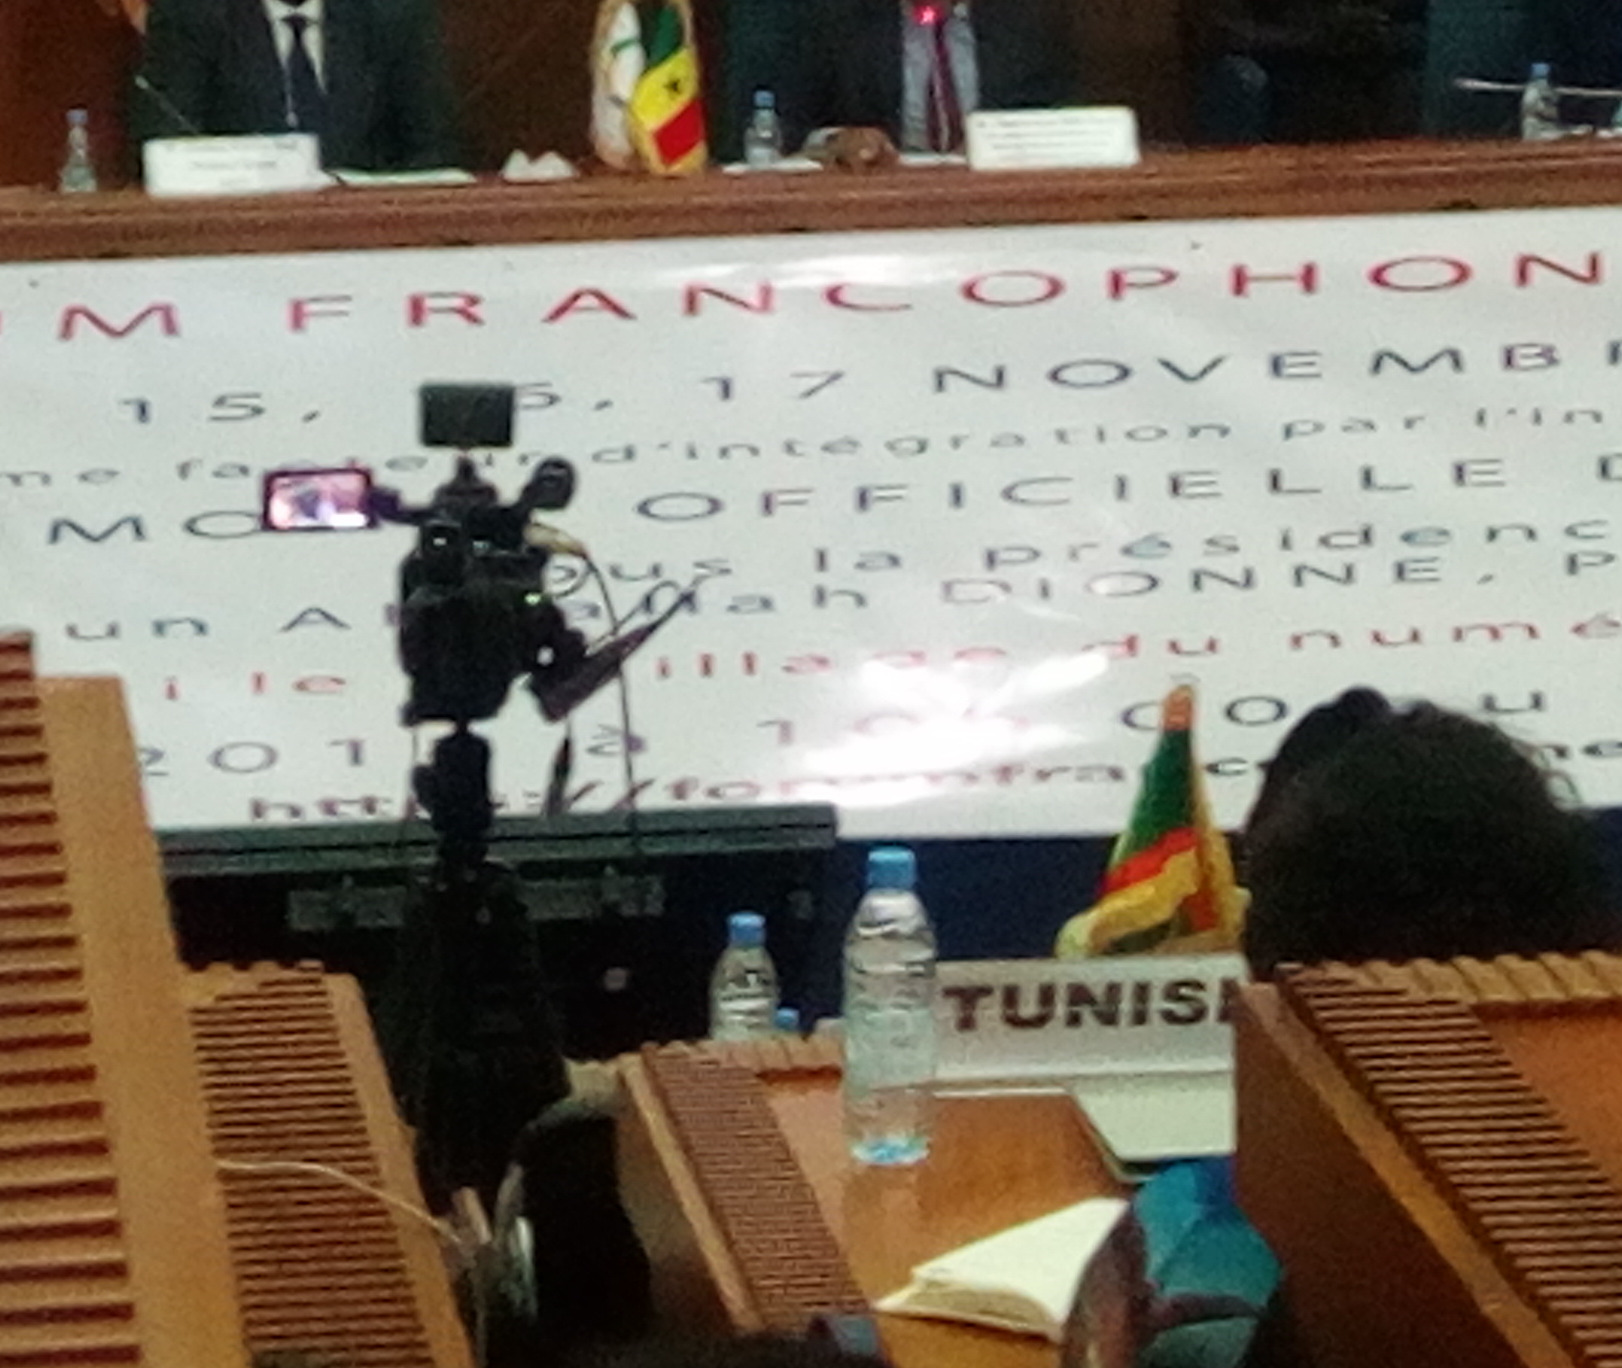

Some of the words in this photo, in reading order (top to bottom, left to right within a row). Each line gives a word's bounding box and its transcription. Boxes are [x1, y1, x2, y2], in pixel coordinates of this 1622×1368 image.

[121, 392, 321, 423] 15,
[701, 370, 845, 401] 17
[591, 424, 1231, 463] d'intégration
[1282, 415, 1426, 441] par
[637, 458, 1505, 521] OFFICIELLE
[814, 546, 901, 573] la
[940, 556, 1495, 606] DIONNE,
